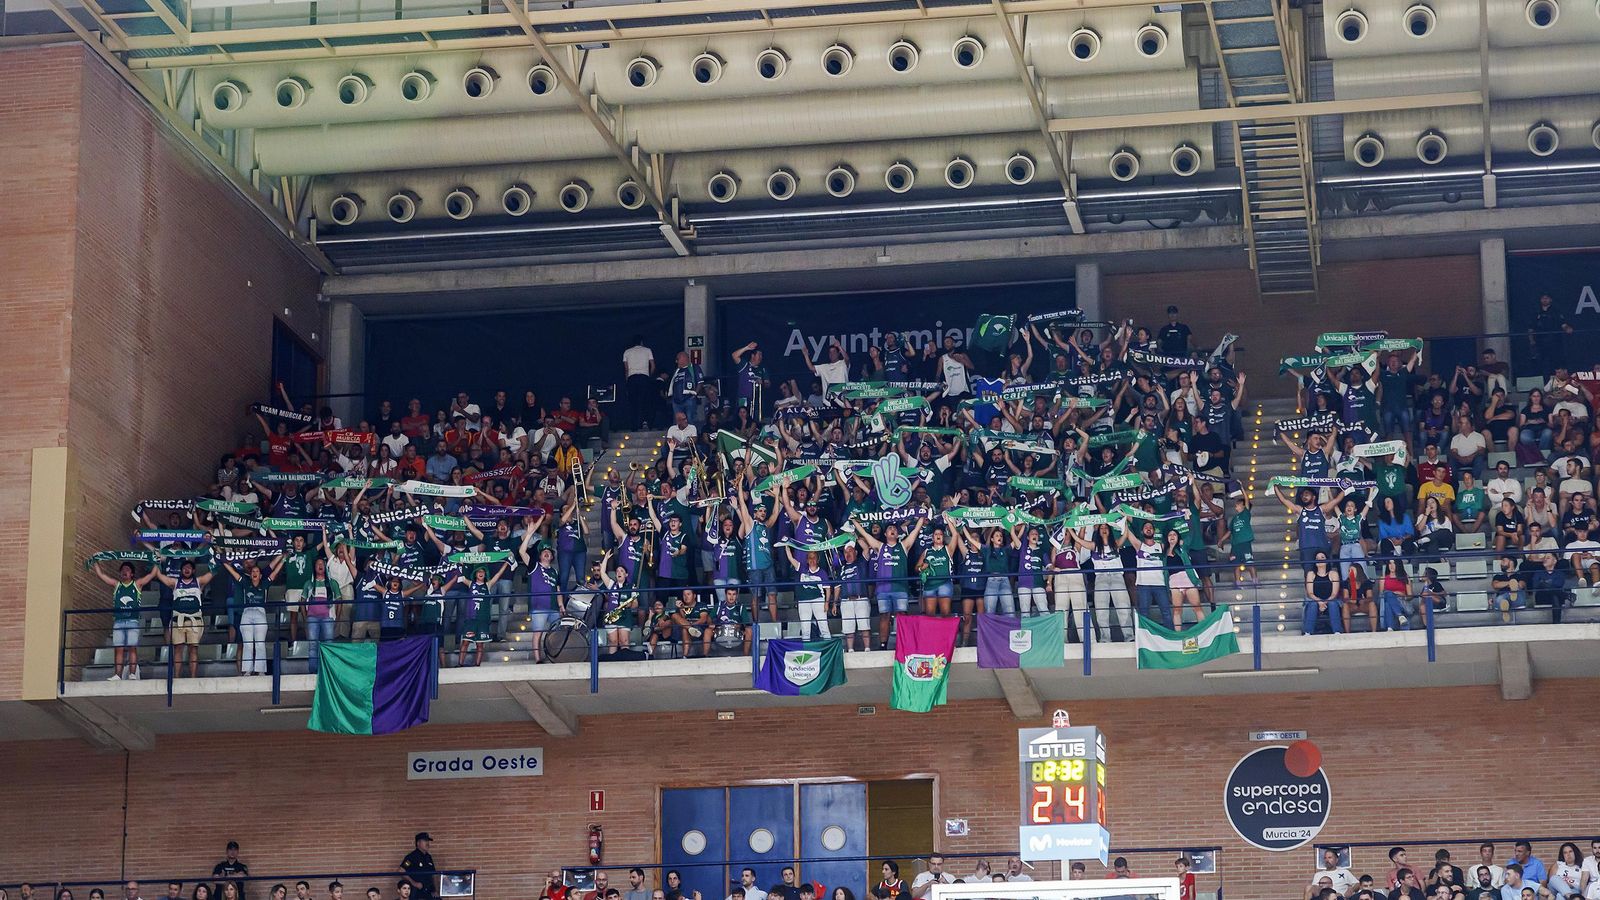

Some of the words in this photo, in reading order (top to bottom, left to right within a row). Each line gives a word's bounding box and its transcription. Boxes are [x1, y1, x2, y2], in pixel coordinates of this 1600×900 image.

[1349, 334, 1385, 342] Baloncesto
[1146, 354, 1195, 366] UNICAJA
[1069, 370, 1122, 385] UNICAJA
[260, 404, 278, 415] UCAM
[278, 408, 302, 420] MURCIA
[302, 414, 312, 422] CB
[1278, 414, 1333, 431] UNICAJA
[1118, 482, 1176, 502] UNICAJA
[144, 500, 192, 509] UNICAJ
[208, 504, 240, 512] BALONCESTO
[370, 504, 430, 524] UNICAJA
[860, 508, 916, 521] UNICAJA
[434, 516, 459, 527] Unicaja
[246, 538, 278, 547] BALONCESTO
[120, 550, 148, 560] Unicaja
[226, 548, 283, 562] UNICAJA
[369, 561, 424, 582] UNICAJA
[788, 664, 816, 672] Fundación
[1029, 743, 1086, 758] LOTUS
[413, 757, 473, 773] Grada
[482, 755, 538, 770] Oeste
[1233, 784, 1321, 799] supercopa
[1242, 797, 1322, 815] endesa
[1266, 830, 1297, 838] Murcia
[1298, 830, 1311, 838] '24
[1056, 837, 1093, 848] Movistar
